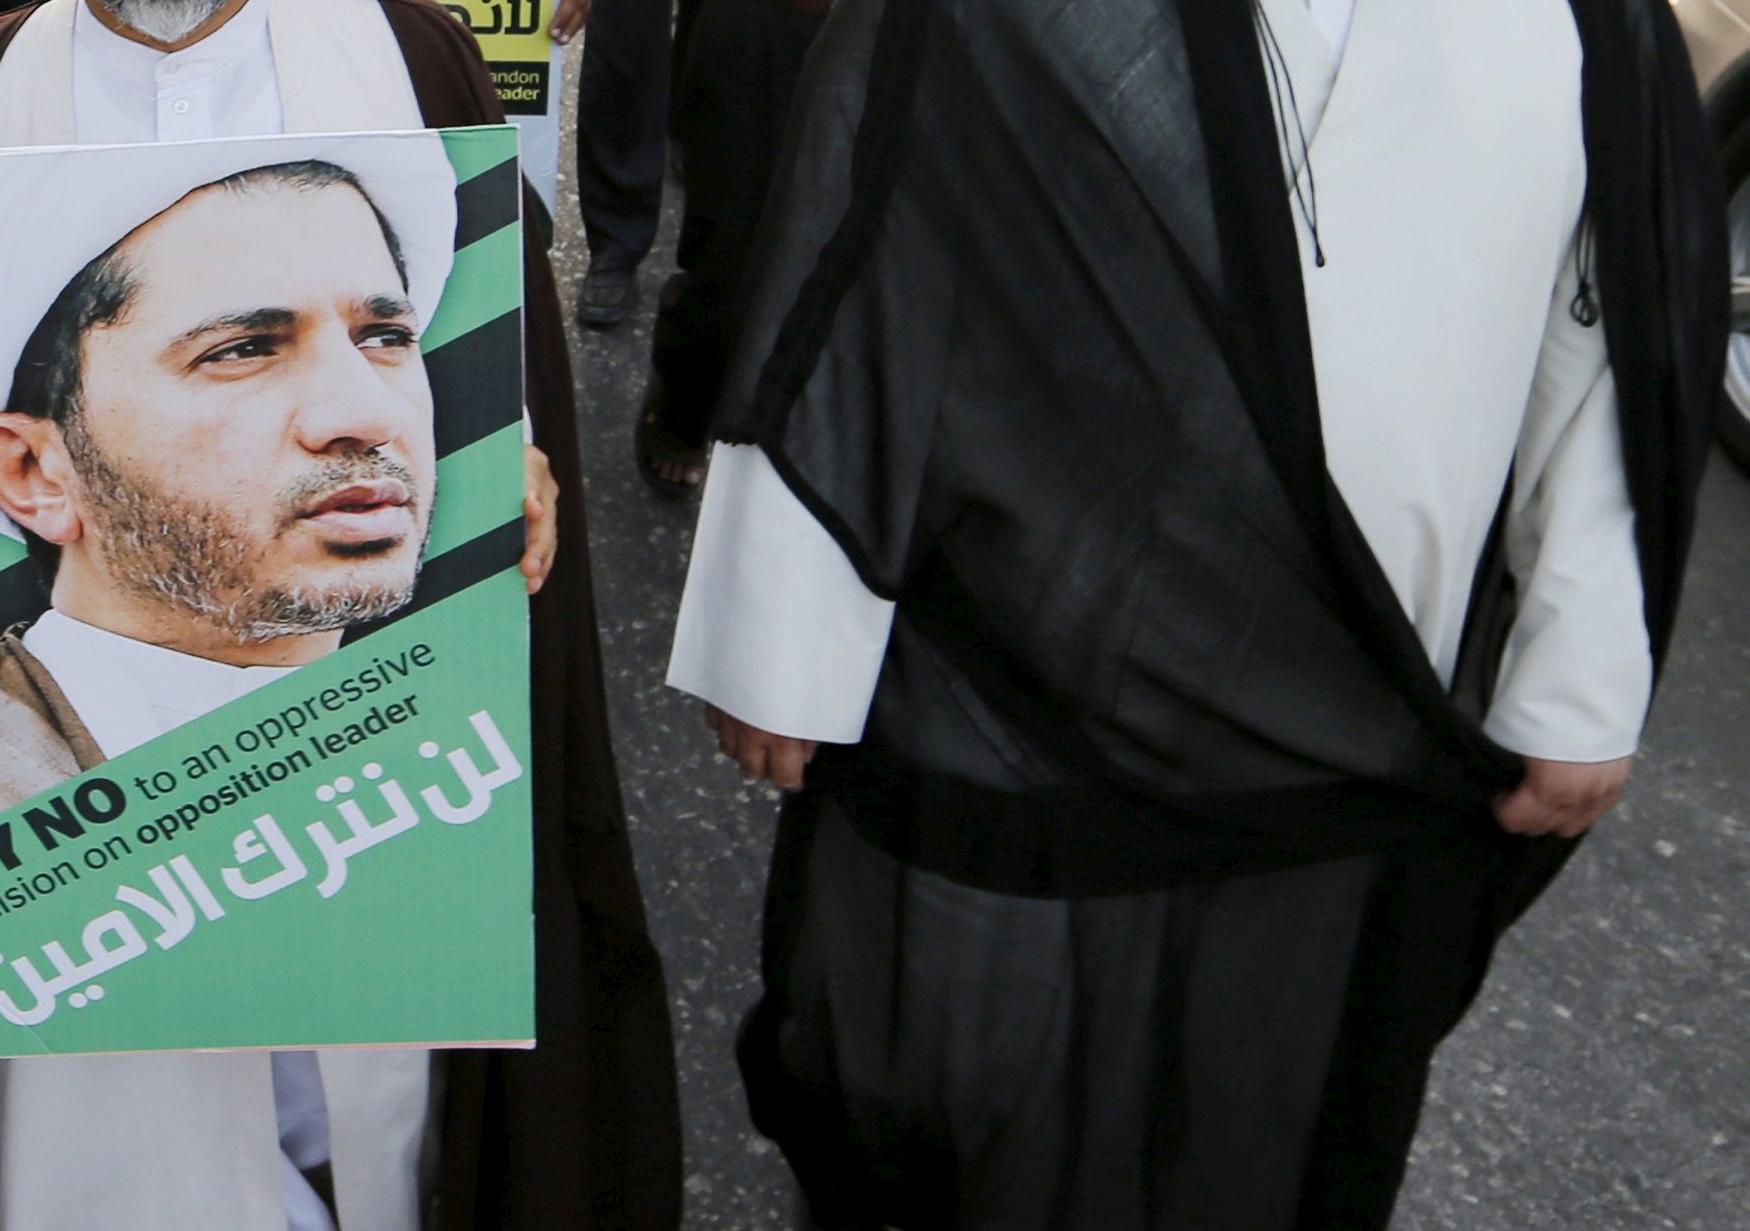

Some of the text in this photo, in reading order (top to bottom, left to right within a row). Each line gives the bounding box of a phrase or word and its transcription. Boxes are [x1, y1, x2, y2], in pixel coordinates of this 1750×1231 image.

[21, 777, 127, 852] NO
[134, 770, 177, 802] to
[181, 743, 231, 780] an
[234, 642, 437, 754] oppressive
[83, 835, 133, 870] on
[136, 749, 313, 846] opposition
[309, 694, 420, 760] leader
[419, 709, 524, 826] لن
[220, 761, 420, 900] نترك
